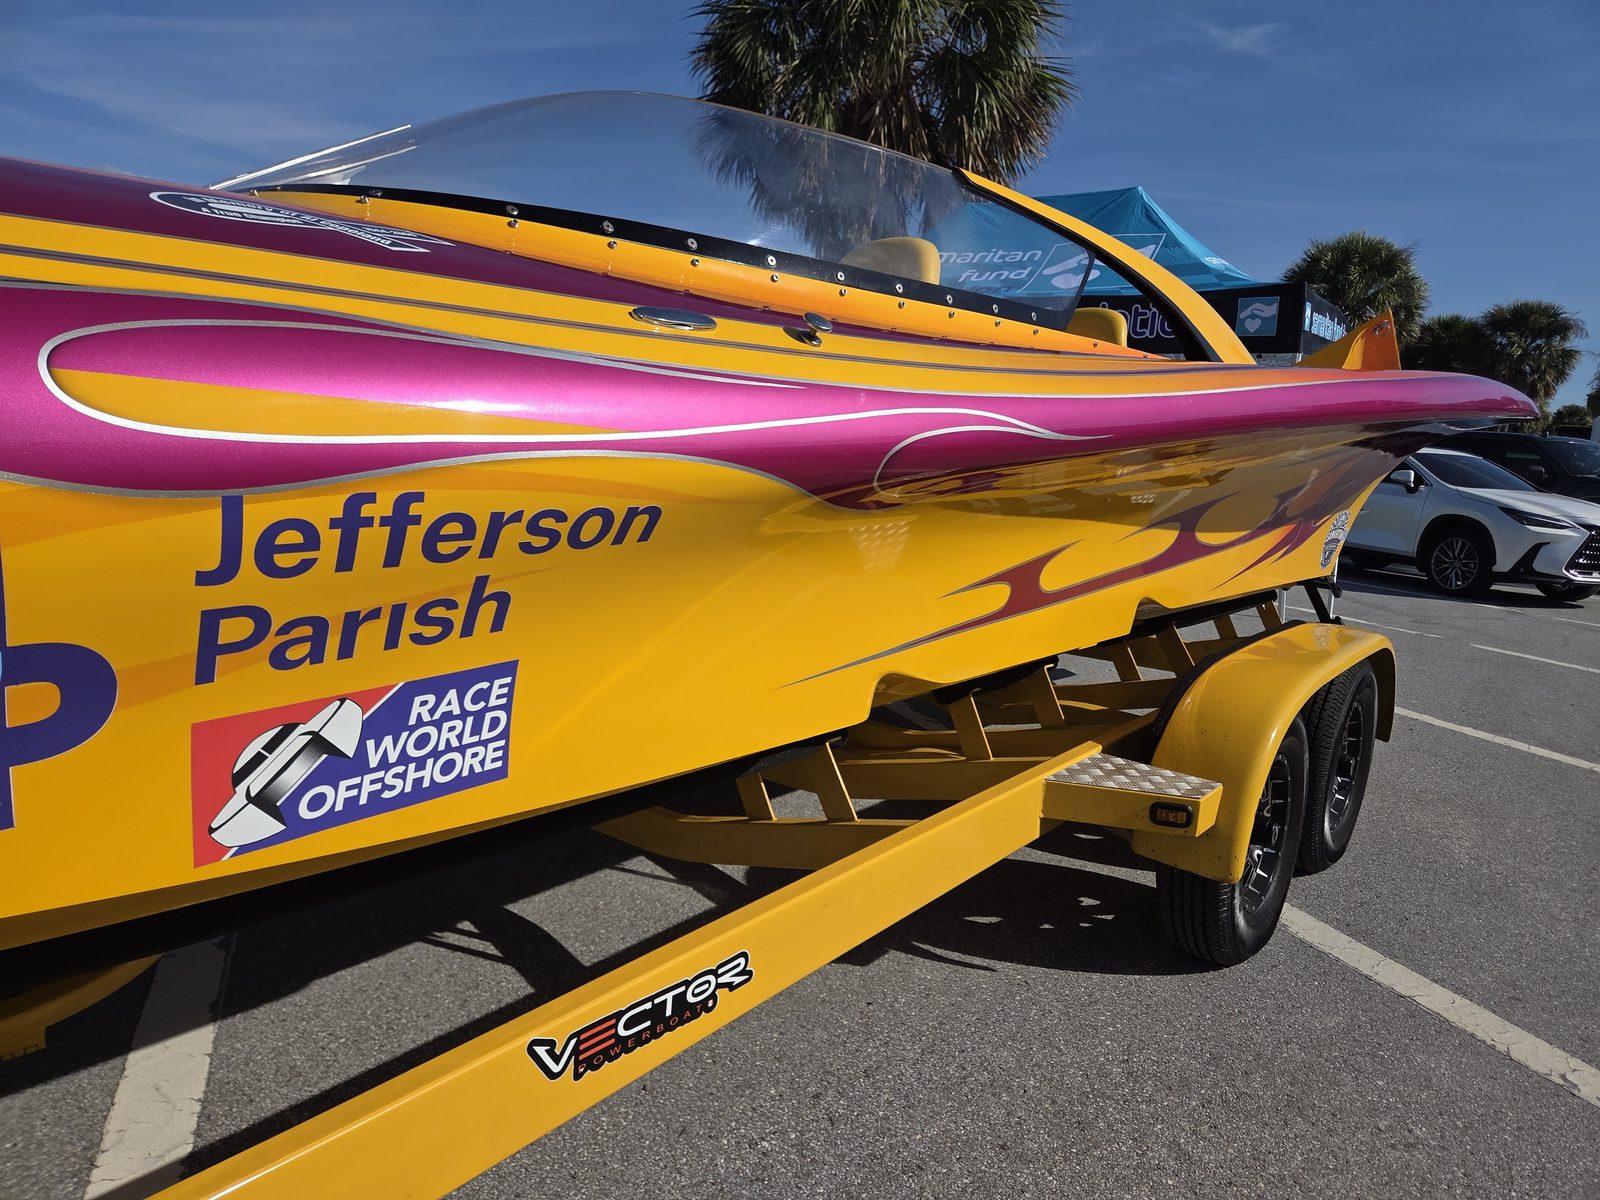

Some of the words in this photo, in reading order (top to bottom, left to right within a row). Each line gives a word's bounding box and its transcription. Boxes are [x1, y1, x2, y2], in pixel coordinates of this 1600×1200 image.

[211, 208, 242, 218] True
[319, 220, 392, 245] Copeland
[958, 266, 1032, 283] fund
[194, 491, 663, 587] Jefferson
[194, 575, 513, 685] Parish
[408, 676, 512, 726] RACE
[366, 710, 508, 769] WORLD
[298, 739, 506, 820] OFFSHORE
[532, 956, 750, 1073] VECTOR
